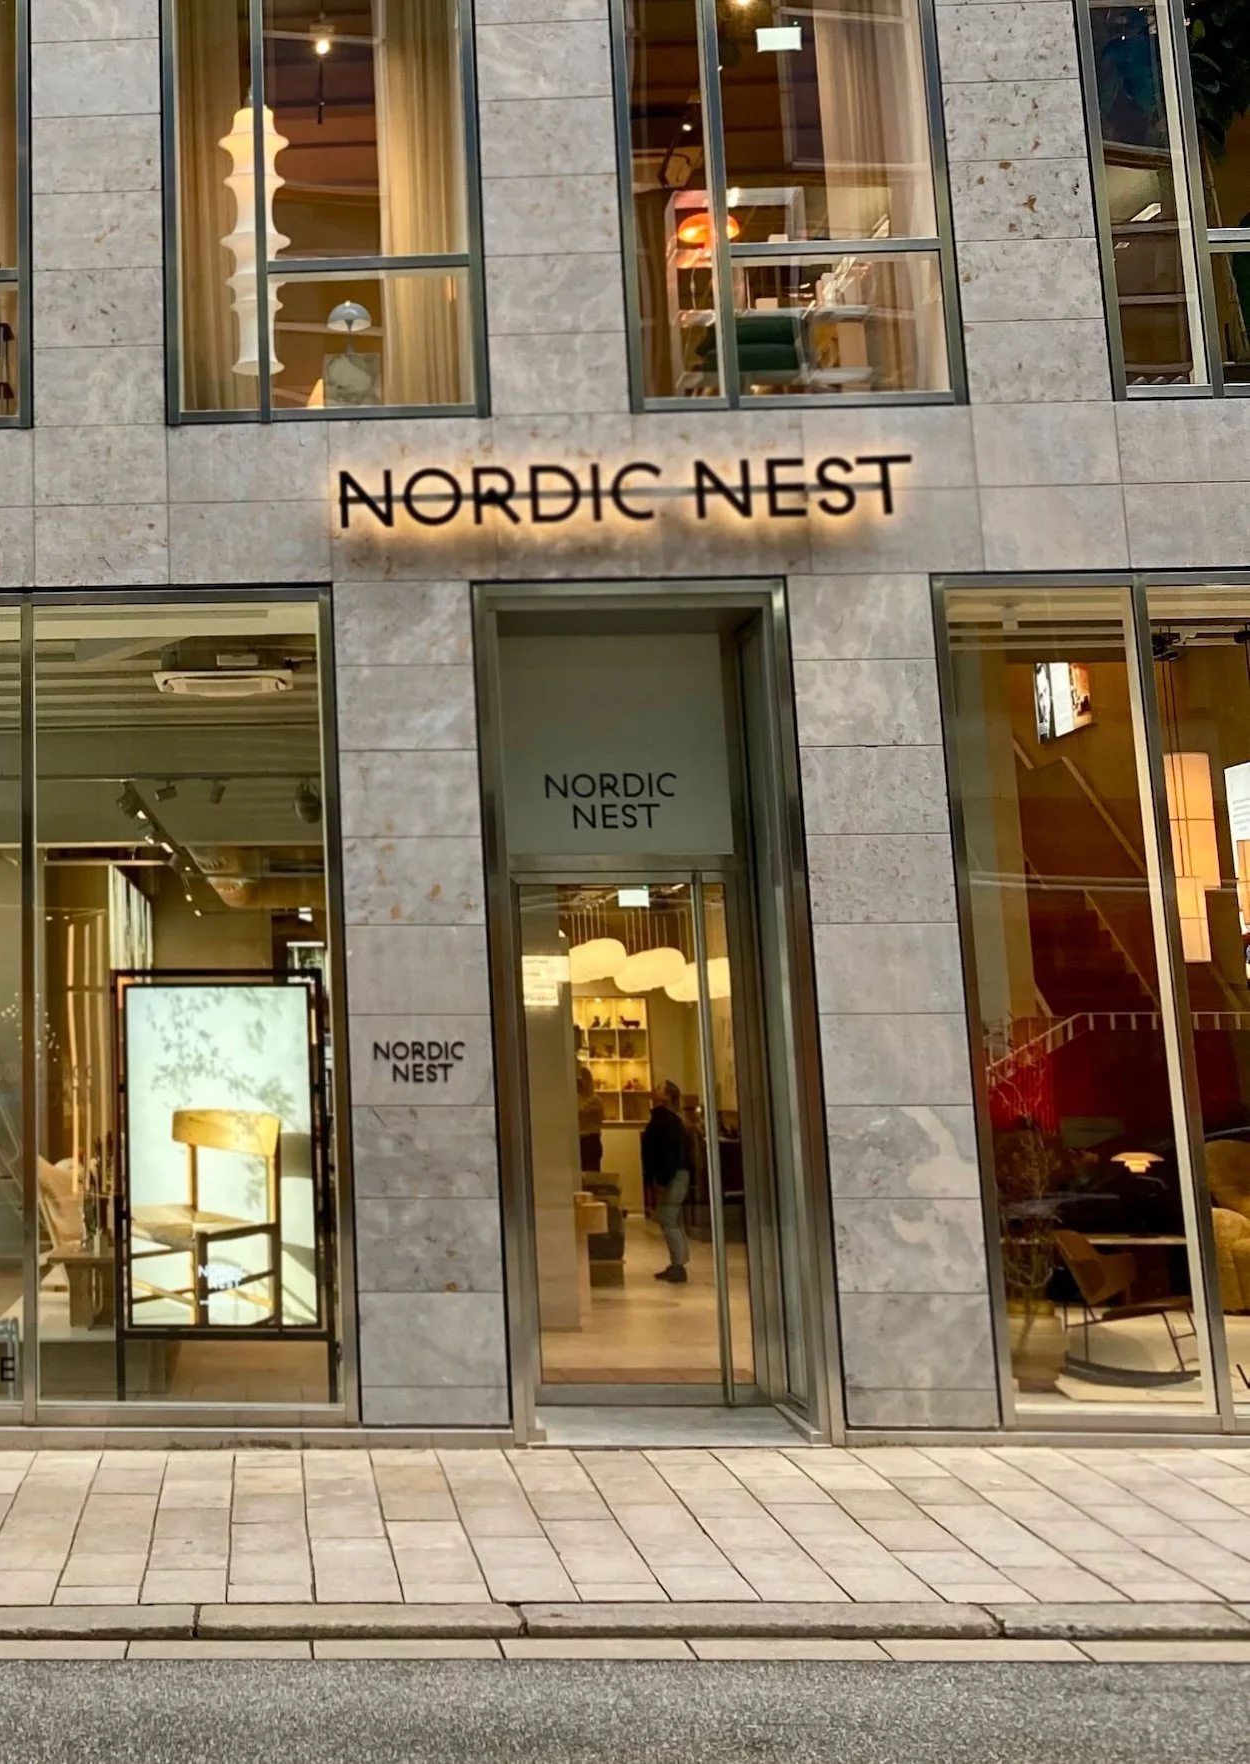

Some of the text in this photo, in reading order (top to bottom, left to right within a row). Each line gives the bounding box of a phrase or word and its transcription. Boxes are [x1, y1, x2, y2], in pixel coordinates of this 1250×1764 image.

[338, 454, 912, 529] NORDIC NEST
[544, 772, 677, 799] NORDIC
[573, 803, 660, 830] NEST
[372, 1041, 466, 1061] NORDIC
[392, 1063, 454, 1083] NEST
